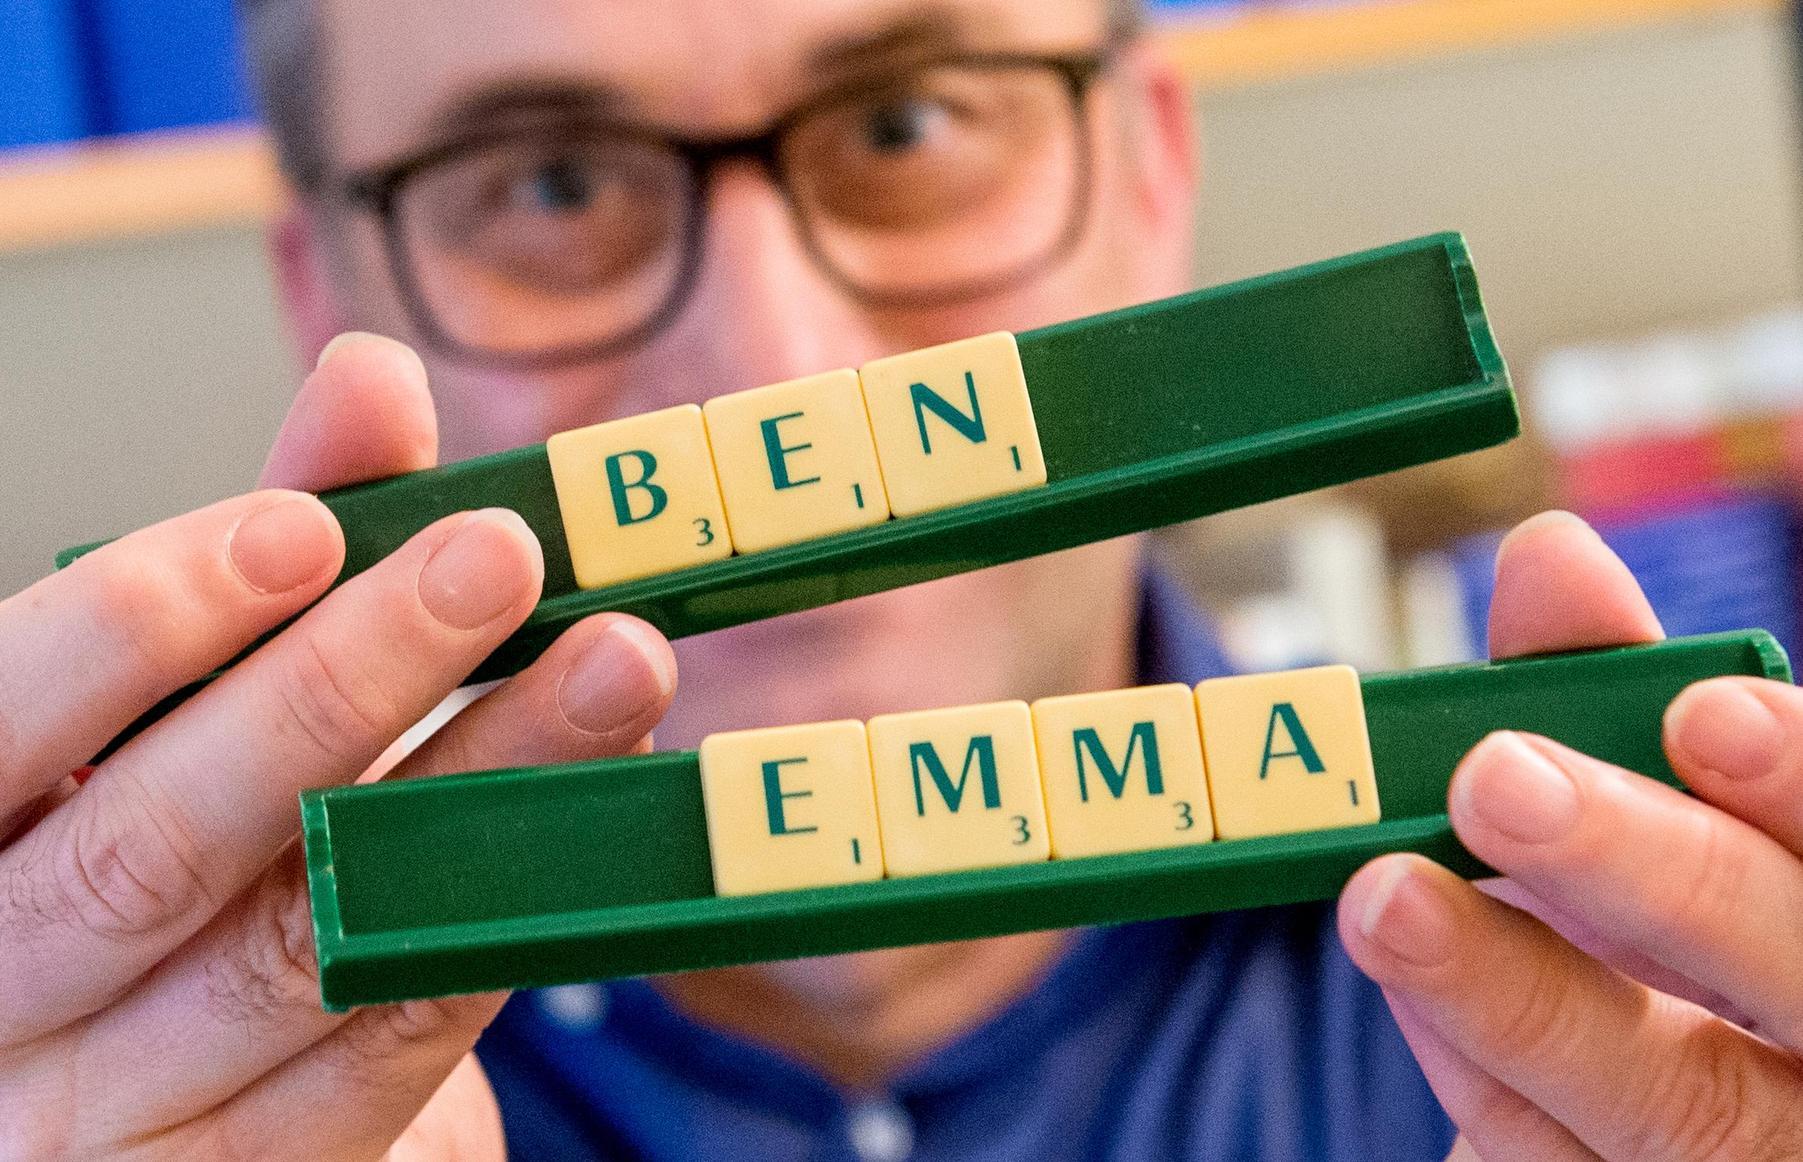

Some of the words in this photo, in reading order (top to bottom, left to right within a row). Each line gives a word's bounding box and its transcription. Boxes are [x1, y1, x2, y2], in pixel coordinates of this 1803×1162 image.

[604, 370, 988, 528] BEN
[693, 517, 717, 547] 3
[852, 482, 865, 510] 1
[1009, 445, 1022, 472] 1
[760, 701, 1327, 837] EMMA
[850, 838, 862, 865] 1
[1011, 815, 1032, 844] 3
[1173, 801, 1195, 831] 3
[1348, 780, 1360, 807] 1
